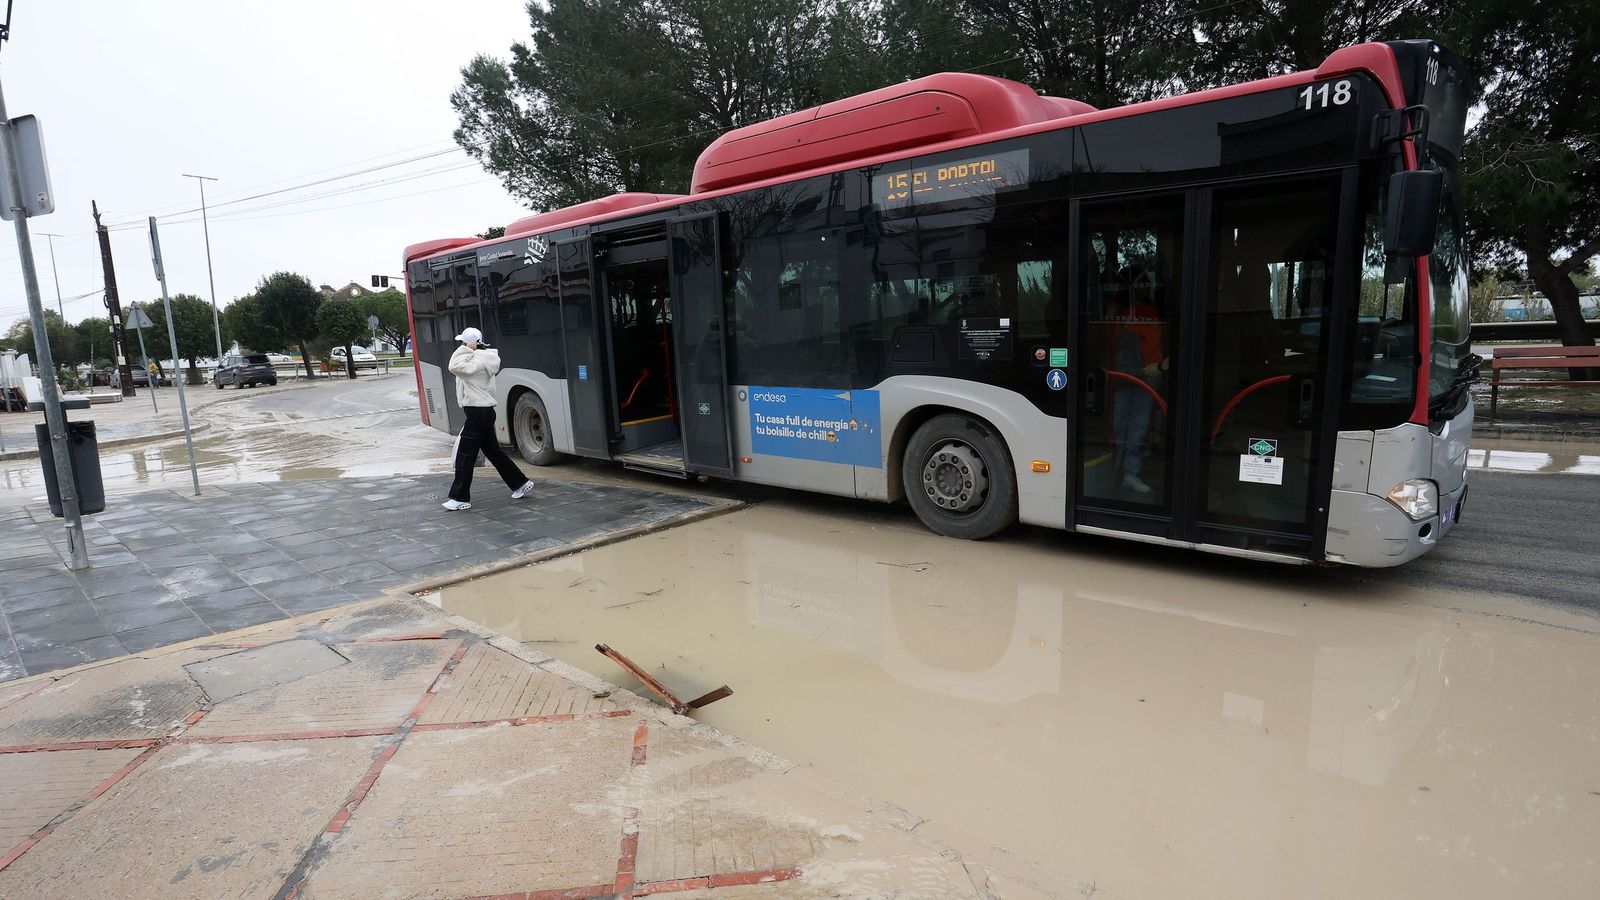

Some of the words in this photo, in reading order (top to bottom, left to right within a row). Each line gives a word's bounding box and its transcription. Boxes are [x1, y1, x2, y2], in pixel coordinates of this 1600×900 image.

[1426, 56, 1439, 86] 118
[1300, 80, 1352, 110] 118
[887, 173, 909, 200] 15
[753, 391, 787, 403] endesa
[755, 413, 765, 423] Tu
[766, 416, 785, 425] casa
[785, 415, 800, 426] full
[801, 416, 812, 427] de
[755, 425, 765, 435] tu
[766, 426, 795, 438] bolsillo
[796, 428, 807, 439] de
